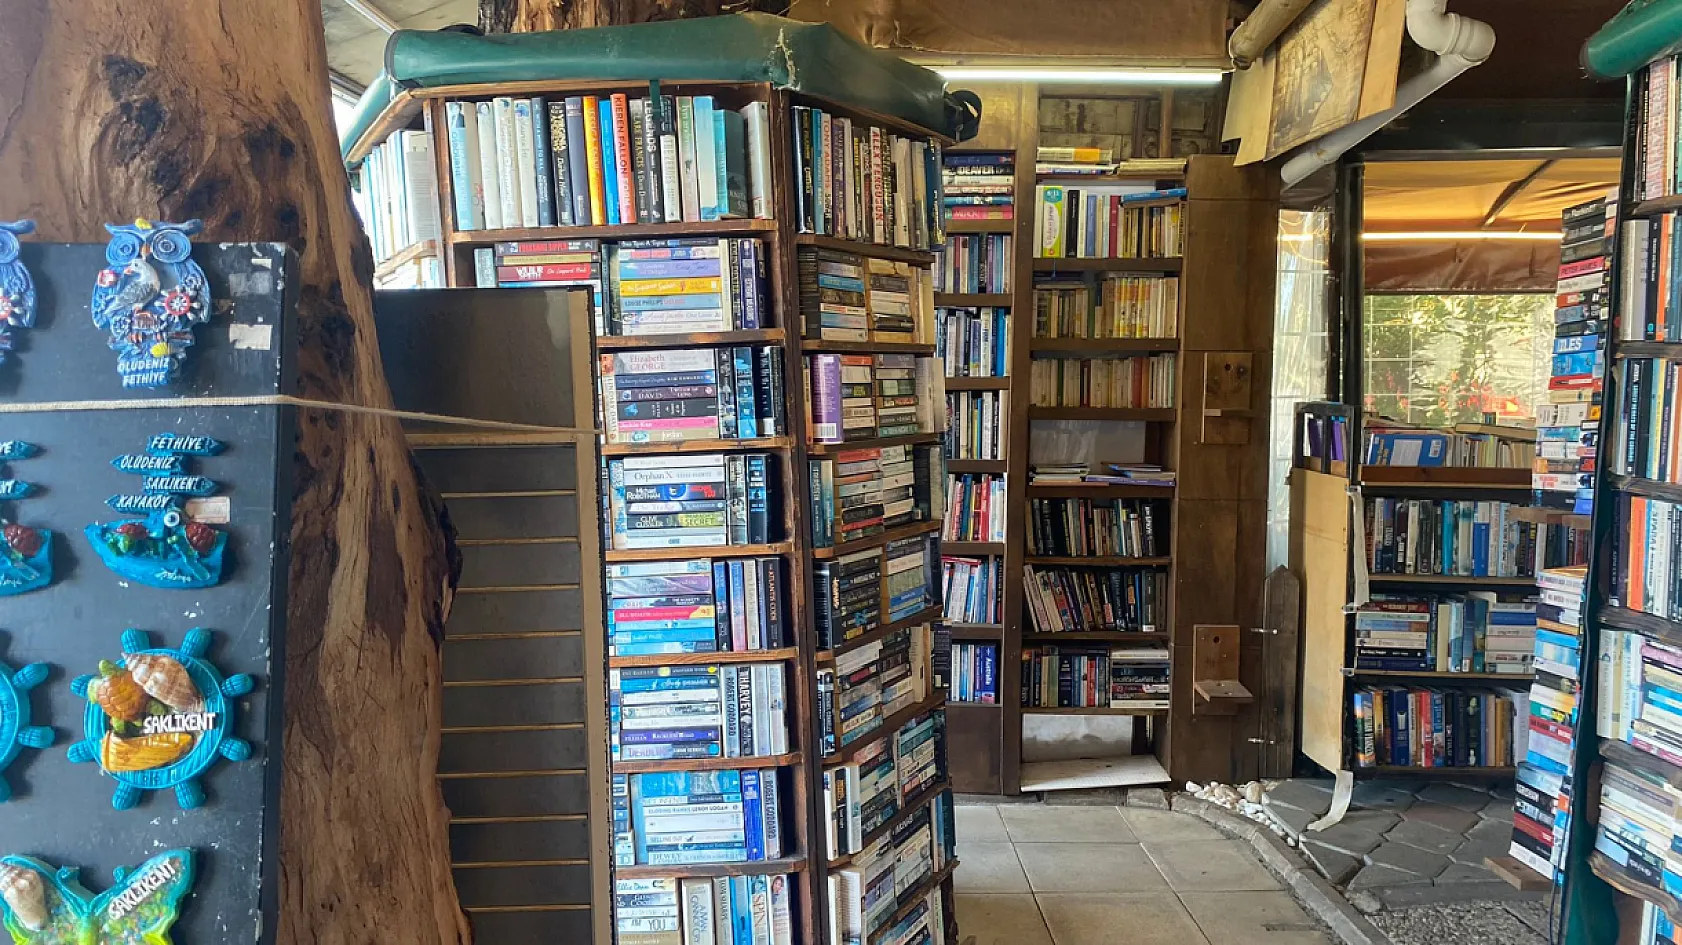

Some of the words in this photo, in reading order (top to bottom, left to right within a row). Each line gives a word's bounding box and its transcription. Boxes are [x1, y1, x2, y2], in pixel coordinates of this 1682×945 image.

[615, 96, 625, 133] KIEREN
[618, 136, 629, 174] FALLON
[629, 353, 665, 363] Elizabeth
[634, 473, 665, 482] Orphan
[739, 677, 751, 714] HARVEY
[142, 712, 216, 734] SAKLIKENT
[108, 857, 177, 920] SAKLIKENT
